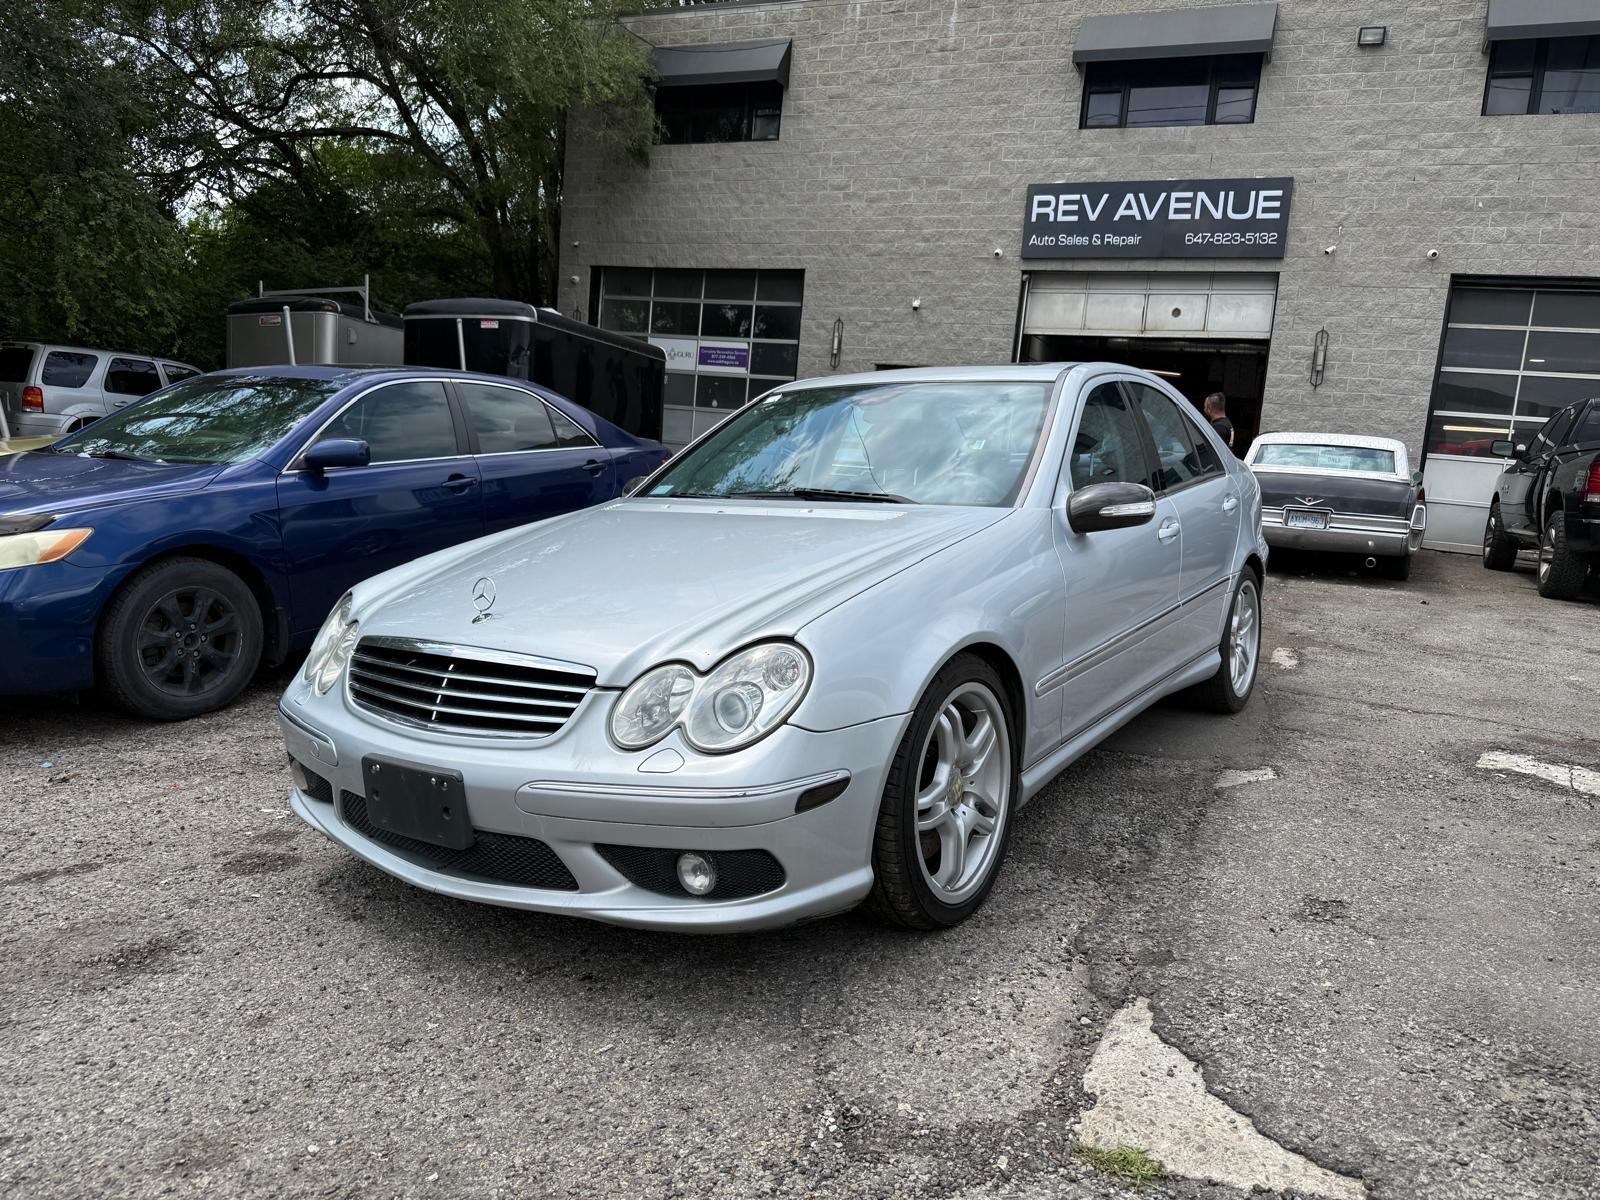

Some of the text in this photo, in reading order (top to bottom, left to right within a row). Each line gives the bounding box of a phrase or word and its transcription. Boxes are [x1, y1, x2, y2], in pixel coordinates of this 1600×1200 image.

[1030, 190, 1284, 223] REV AVENUE
[1028, 233, 1142, 247] Auto Sales & Repair
[1185, 232, 1278, 245] 647-823-5132
